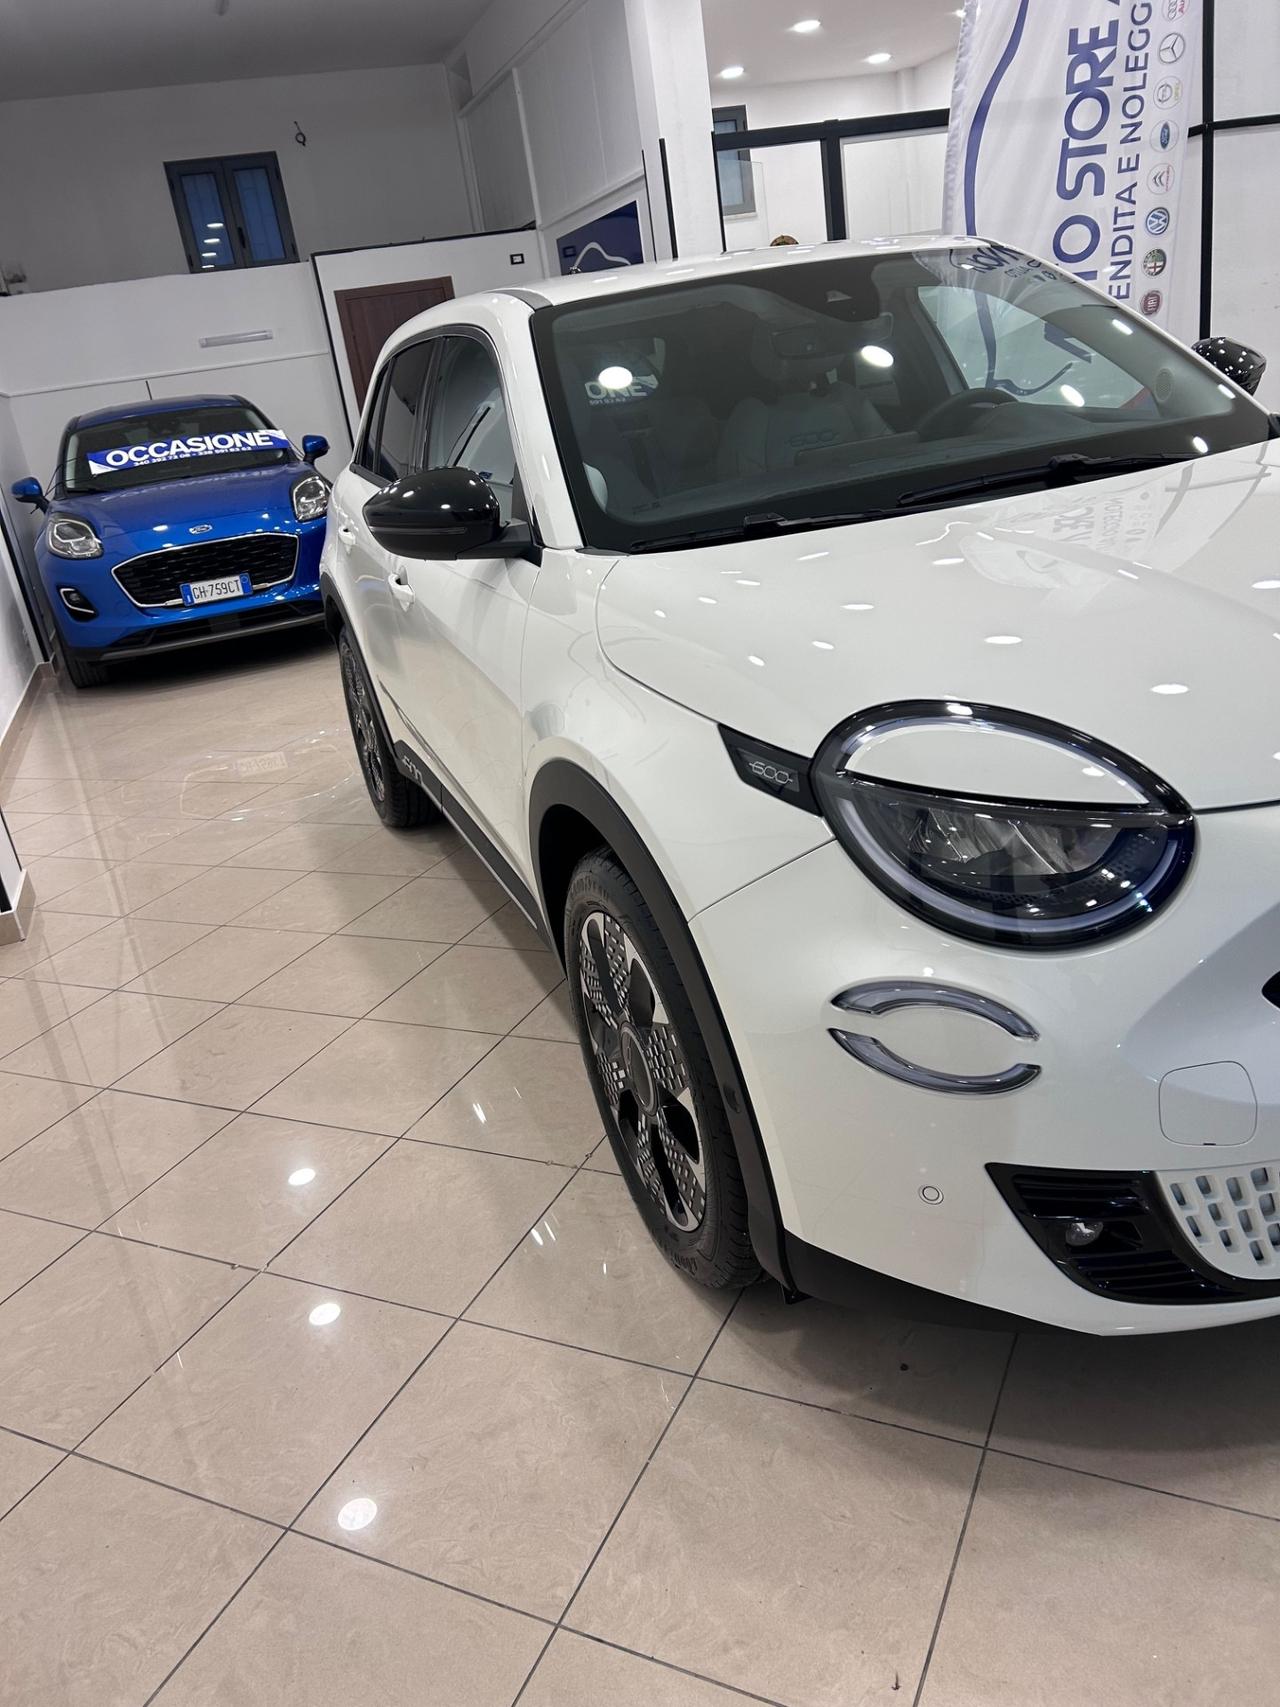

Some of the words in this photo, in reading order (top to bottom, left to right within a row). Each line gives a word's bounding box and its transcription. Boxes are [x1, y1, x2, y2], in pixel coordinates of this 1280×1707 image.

[1056, 18, 1119, 201] STORE
[1119, 2, 1153, 145] NOLEGG
[1117, 154, 1140, 174] E
[1109, 181, 1138, 300] ENDITA
[105, 433, 273, 466] OCCASIONE
[749, 761, 792, 784] 600
